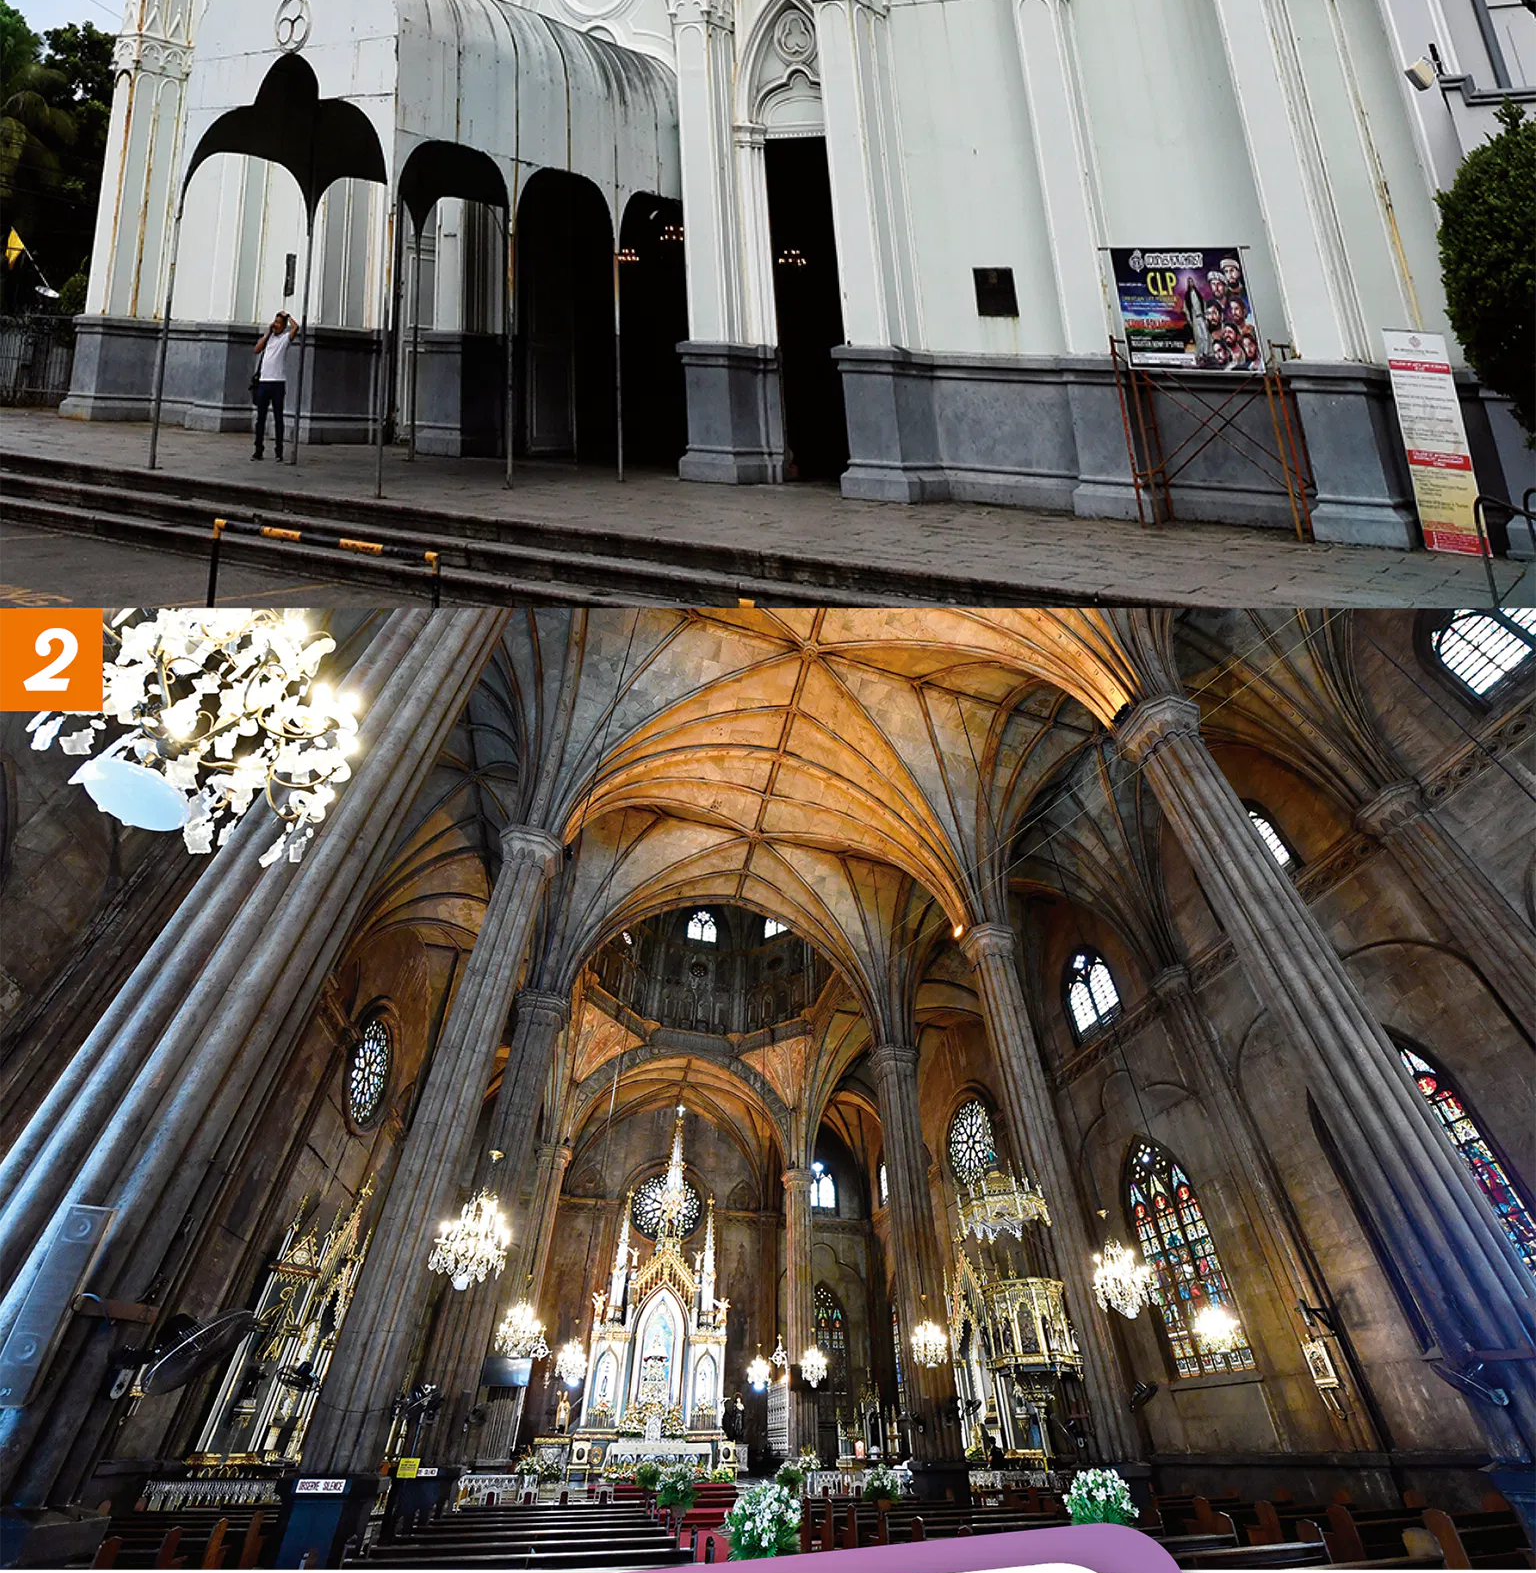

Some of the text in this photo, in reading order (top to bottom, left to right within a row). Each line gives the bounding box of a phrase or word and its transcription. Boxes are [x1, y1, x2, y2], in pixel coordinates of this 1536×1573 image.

[1146, 272, 1177, 296] CLP
[298, 1481, 344, 1491] OBSERVE SILENCE
